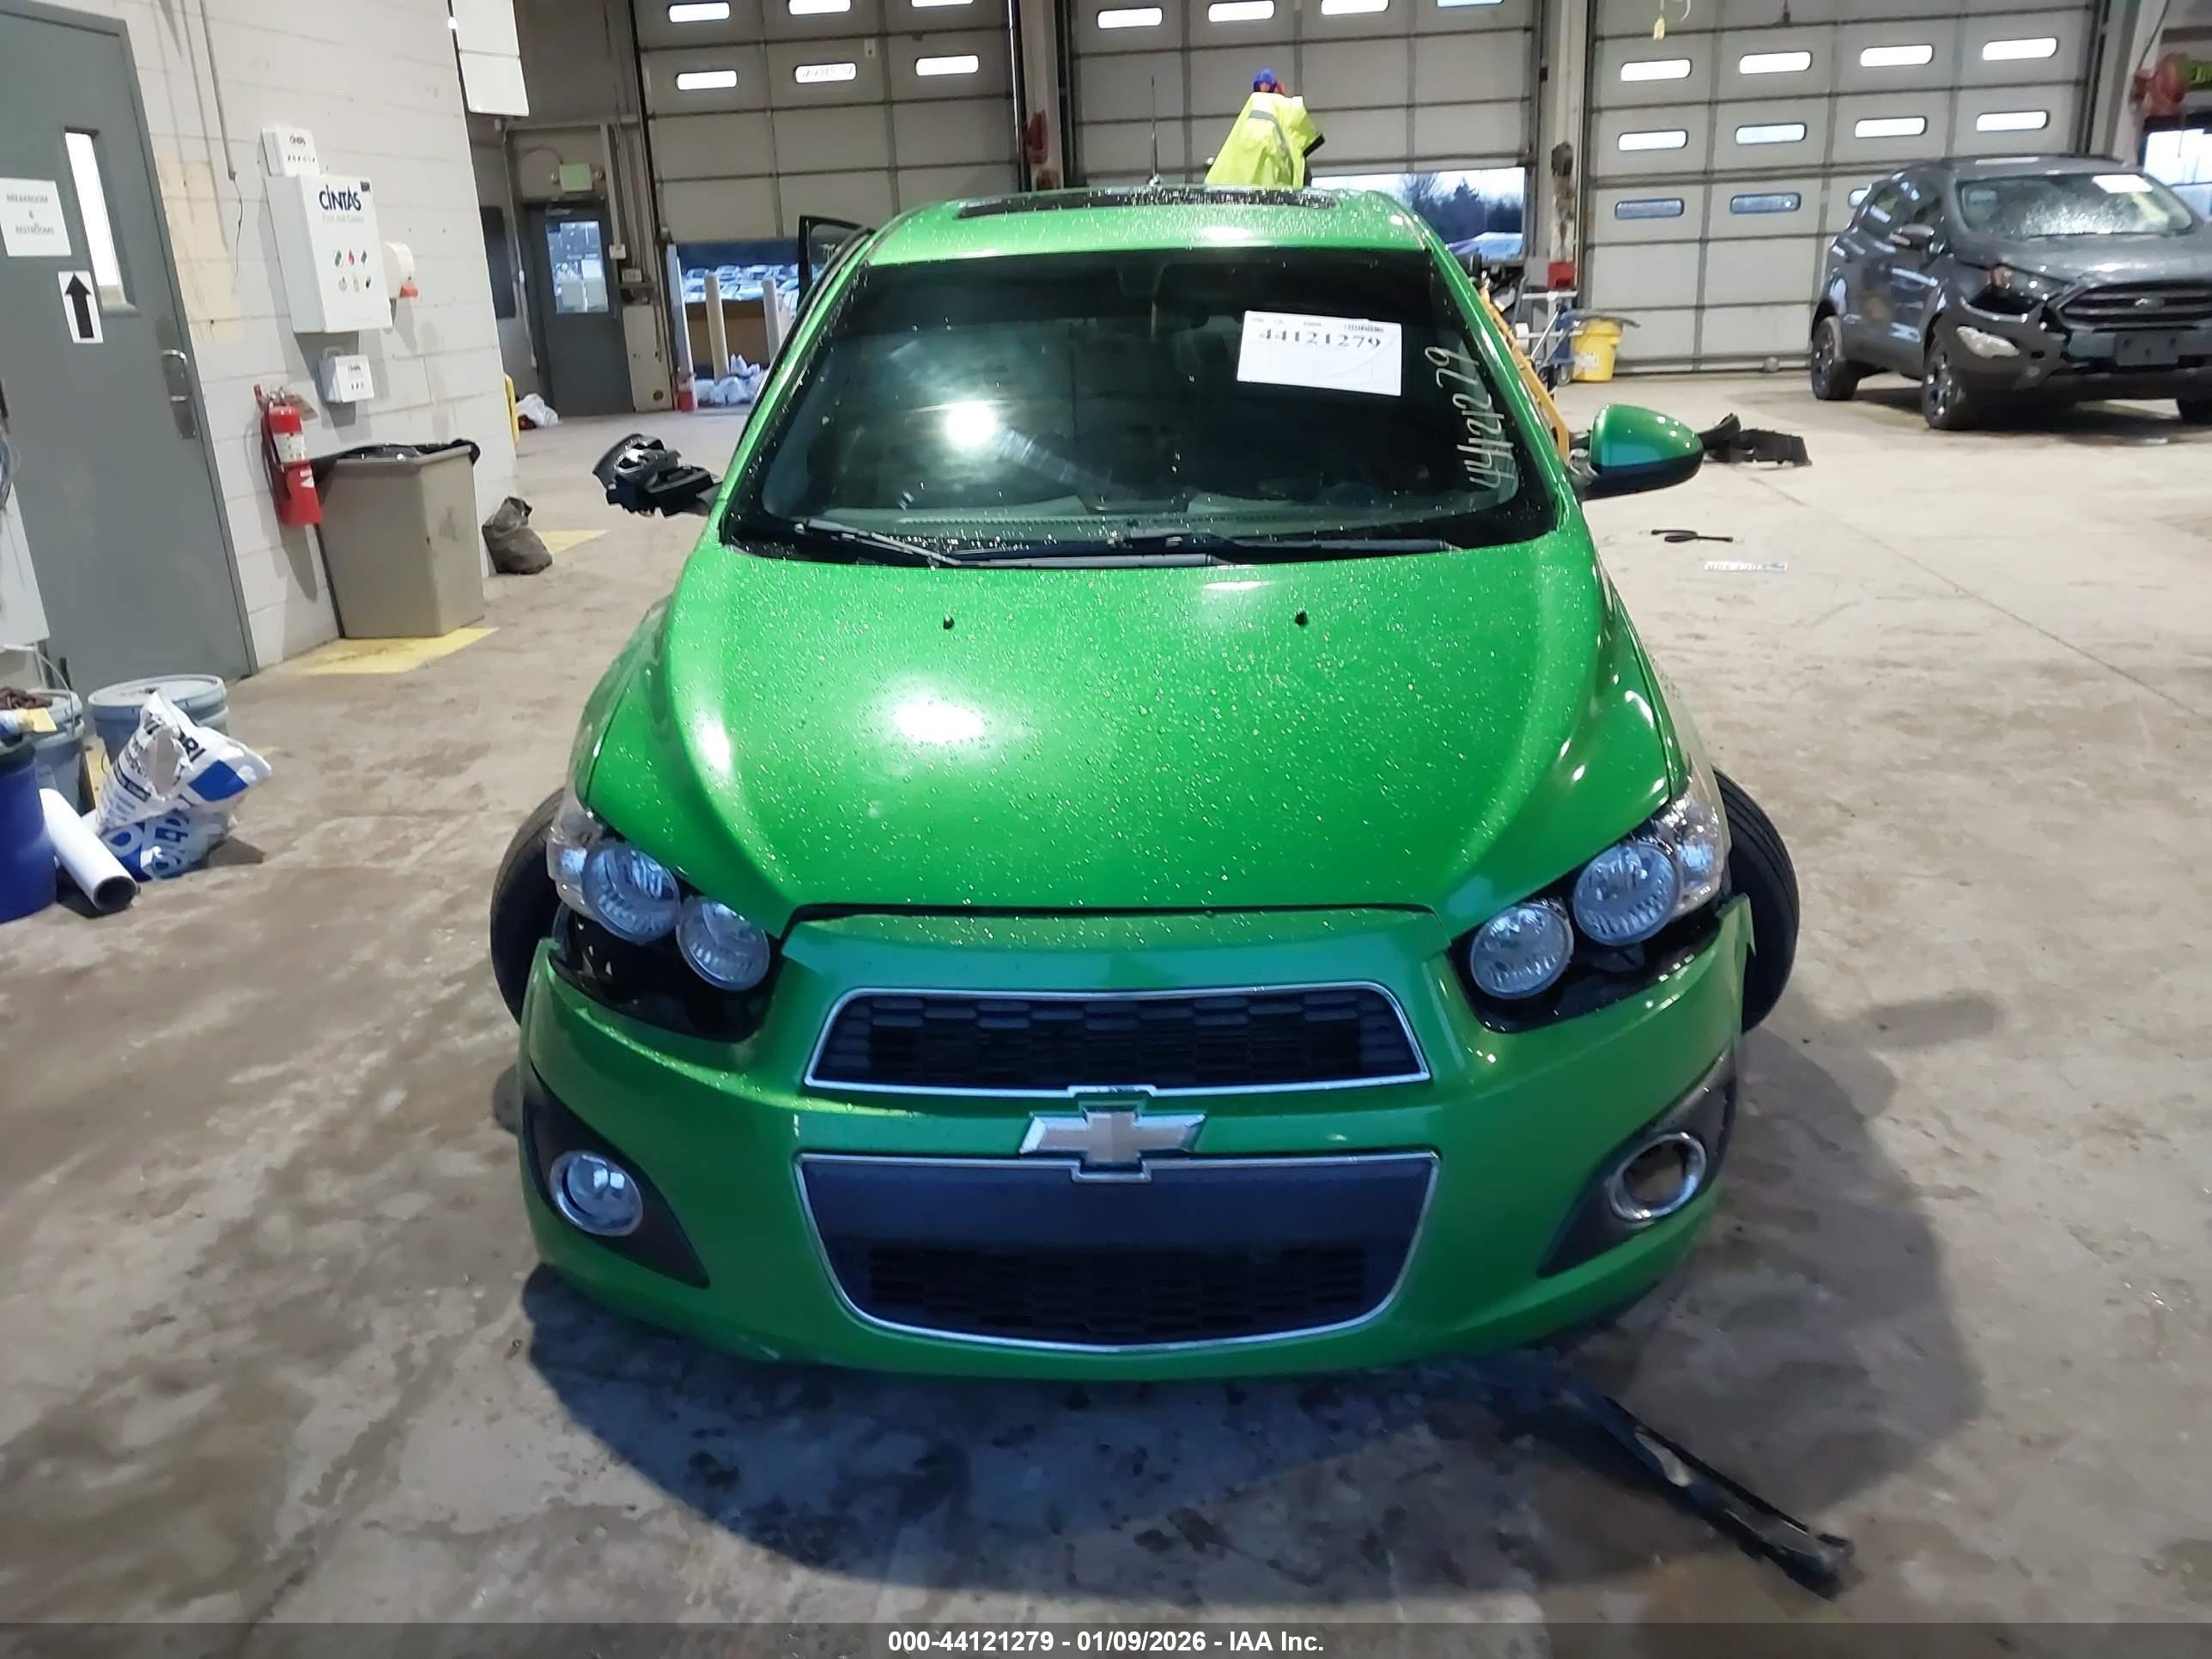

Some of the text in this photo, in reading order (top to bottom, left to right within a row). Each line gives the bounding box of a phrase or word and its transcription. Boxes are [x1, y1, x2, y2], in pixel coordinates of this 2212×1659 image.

[319, 184, 362, 212] CINTAS
[1259, 328, 1382, 349] 44121279
[1425, 346, 1516, 489] 44121279
